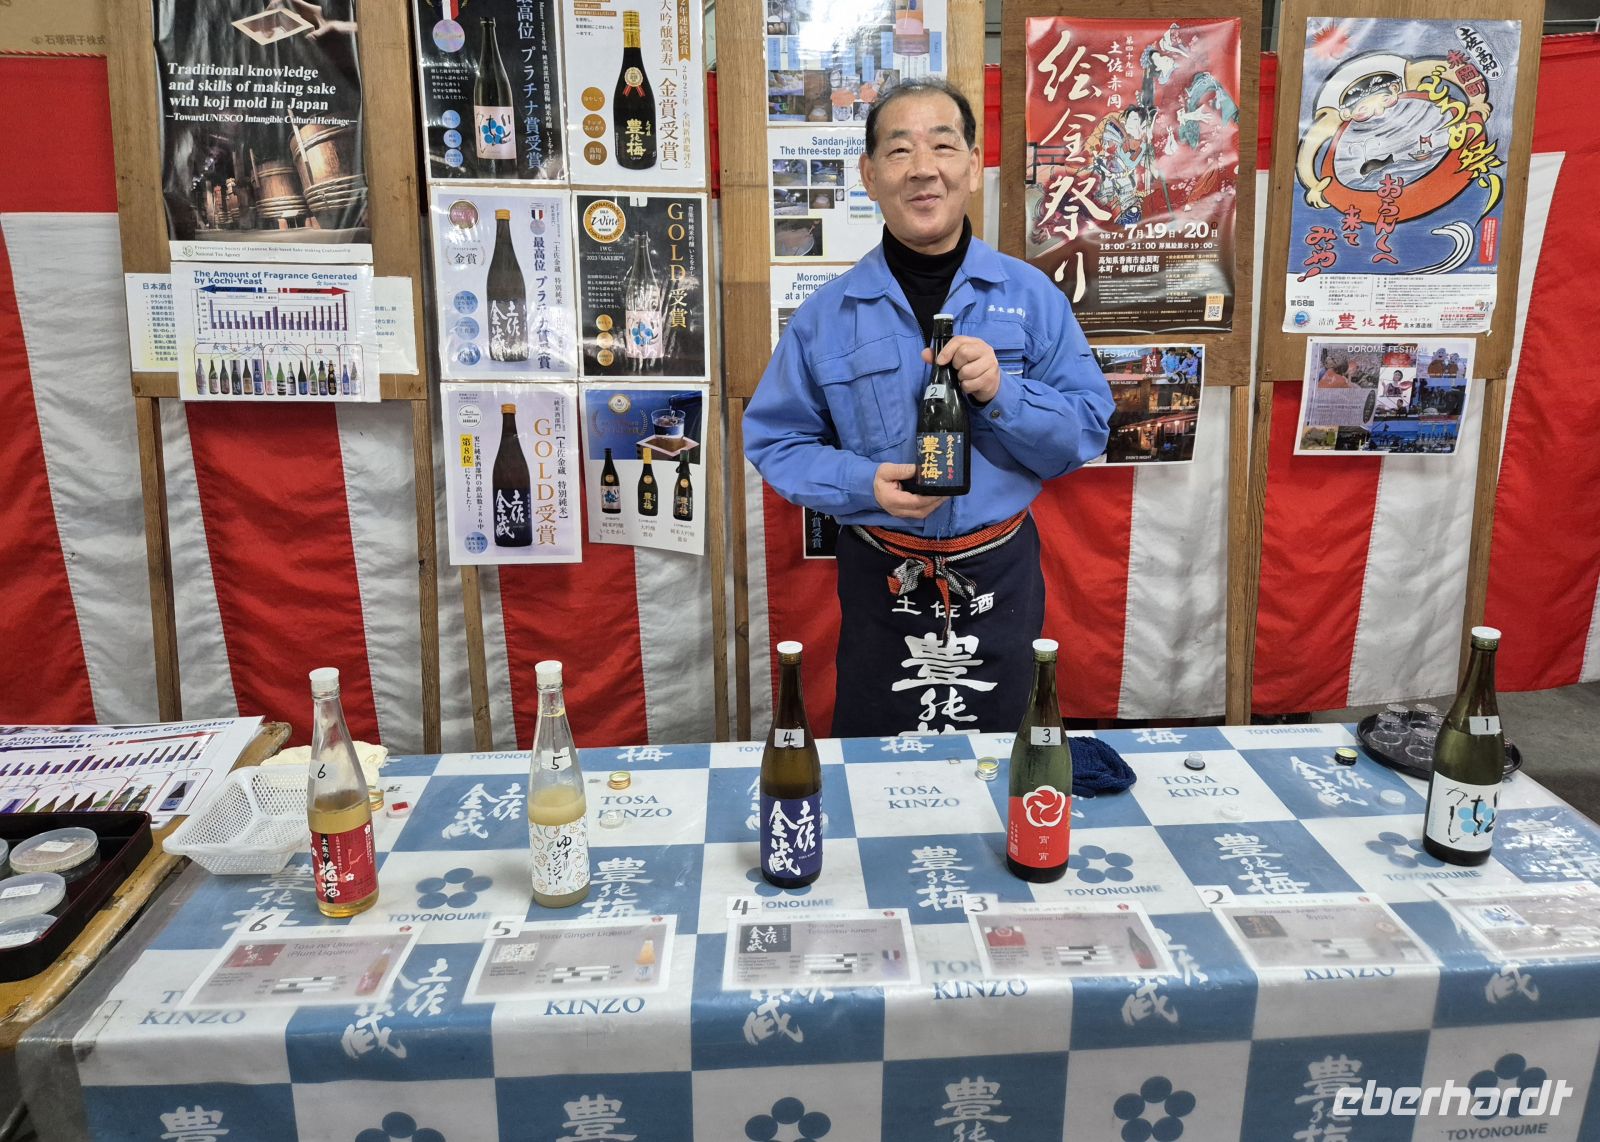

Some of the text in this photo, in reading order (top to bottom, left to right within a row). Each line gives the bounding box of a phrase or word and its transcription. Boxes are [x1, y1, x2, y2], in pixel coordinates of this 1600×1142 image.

[167, 62, 319, 79] Traditional knowledge
[1107, 40, 1124, 109] 土佐赤岡
[168, 79, 337, 96] and skills of making sake
[516, 0, 543, 169] 高位 プラチナ賞受賞
[169, 96, 328, 112] with koji mold in Japan
[205, 113, 244, 123] UNESCO
[244, 114, 284, 125] Intangible
[284, 115, 317, 125] Cultural
[779, 146, 796, 156] The
[798, 146, 841, 157] three-step
[1036, 30, 1112, 304] 絵金祭り
[591, 215, 618, 226] Wine
[1341, 203, 1364, 247] 来て
[1371, 173, 1405, 265] おらんくへ
[1131, 242, 1157, 250] 21:00
[454, 252, 478, 265] 金賞
[533, 236, 546, 272] 最高位
[1098, 255, 1161, 265] 高知県香南市赤岡町
[667, 203, 690, 329] GOLD 受賞
[194, 270, 211, 278] The
[213, 270, 249, 279] Amount
[263, 271, 310, 281] Fragrance
[311, 272, 358, 281] Generated
[194, 277, 263, 286] by Kochi-Yeast
[785, 292, 800, 301] at a
[1347, 345, 1429, 354] DOROME FESTIVAL
[930, 386, 939, 397] 2
[891, 591, 995, 619] 土佐酒
[13, 719, 235, 744] Amount of Fragrance Generated
[1247, 727, 1323, 736] TOYONOUME
[1484, 718, 1489, 731] 1
[783, 731, 795, 745] 4
[1041, 728, 1051, 743] 3
[470, 753, 530, 761] TOYONOU
[551, 755, 564, 770] 5
[317, 763, 327, 779] 6
[1157, 774, 1218, 785] TOSA
[884, 785, 943, 796] TOSA
[1168, 786, 1241, 799] KINZO
[600, 794, 660, 805] TOSA
[888, 797, 961, 810] KINZO
[793, 800, 816, 853] 土佐
[768, 800, 801, 876] 金蔵
[556, 834, 573, 861] ゆず
[551, 850, 563, 885] ジンジャー
[1384, 869, 1483, 882] TOYONOUME
[1063, 884, 1164, 897] TOYONOUME
[1202, 888, 1232, 905] 2
[732, 898, 758, 916] 4
[969, 895, 988, 913] 3
[248, 913, 275, 932] 6
[387, 911, 492, 923] TOYONOUME
[491, 919, 516, 936] 5
[563, 931, 595, 941] Ginger
[931, 978, 1029, 1000] KINZO
[543, 996, 647, 1016] KINZO
[140, 1008, 247, 1026] KINZO
[1446, 1122, 1549, 1142] TOYONOUME
